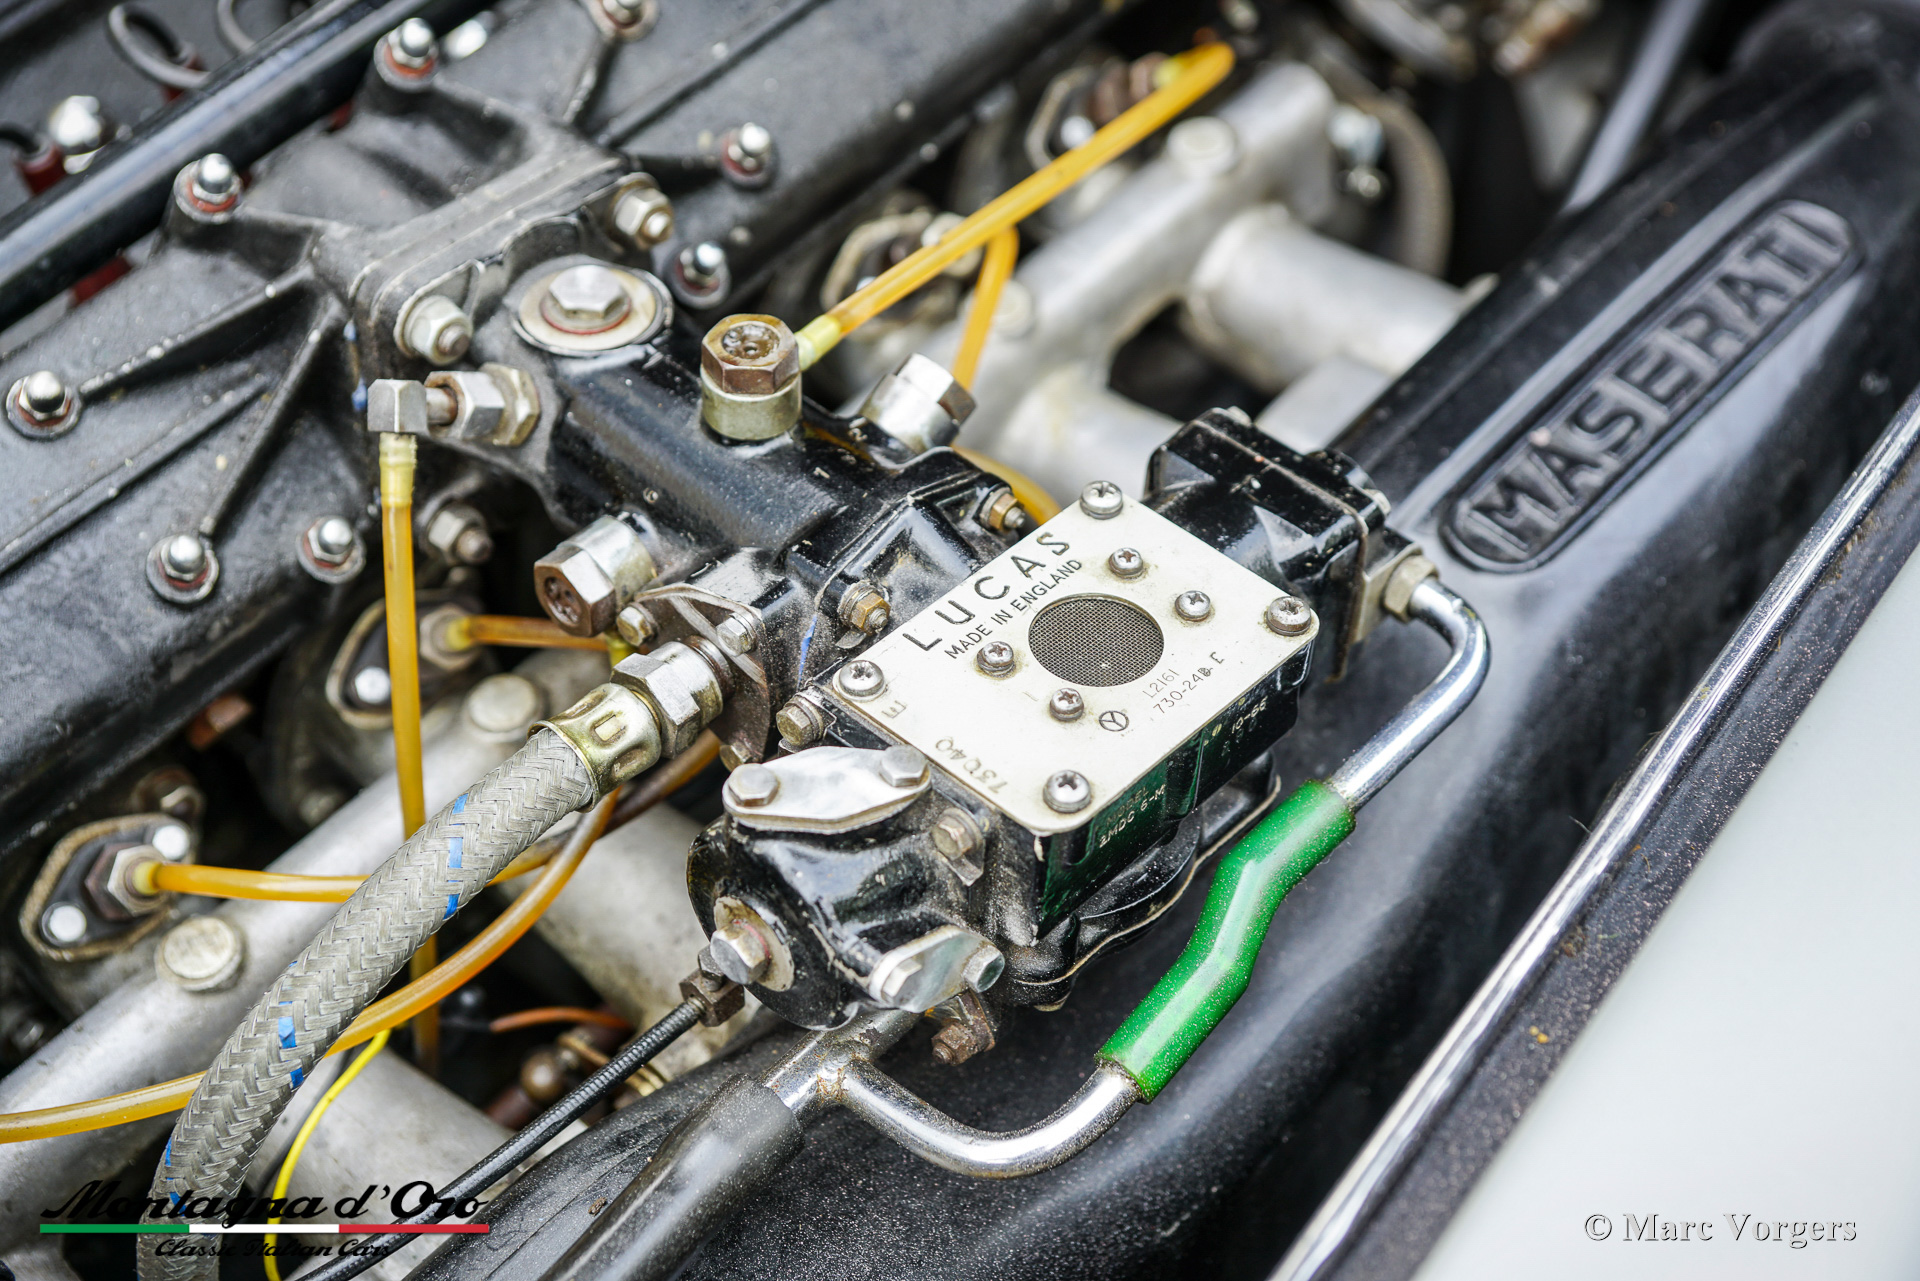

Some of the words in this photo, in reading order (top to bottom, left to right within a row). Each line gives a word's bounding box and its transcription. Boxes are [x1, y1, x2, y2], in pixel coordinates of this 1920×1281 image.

[1464, 208, 1847, 560] MASERATI
[902, 532, 1070, 651] LUCAS
[944, 624, 993, 659] MADE
[990, 609, 1014, 626] IN
[1009, 559, 1083, 612] ENGLAND
